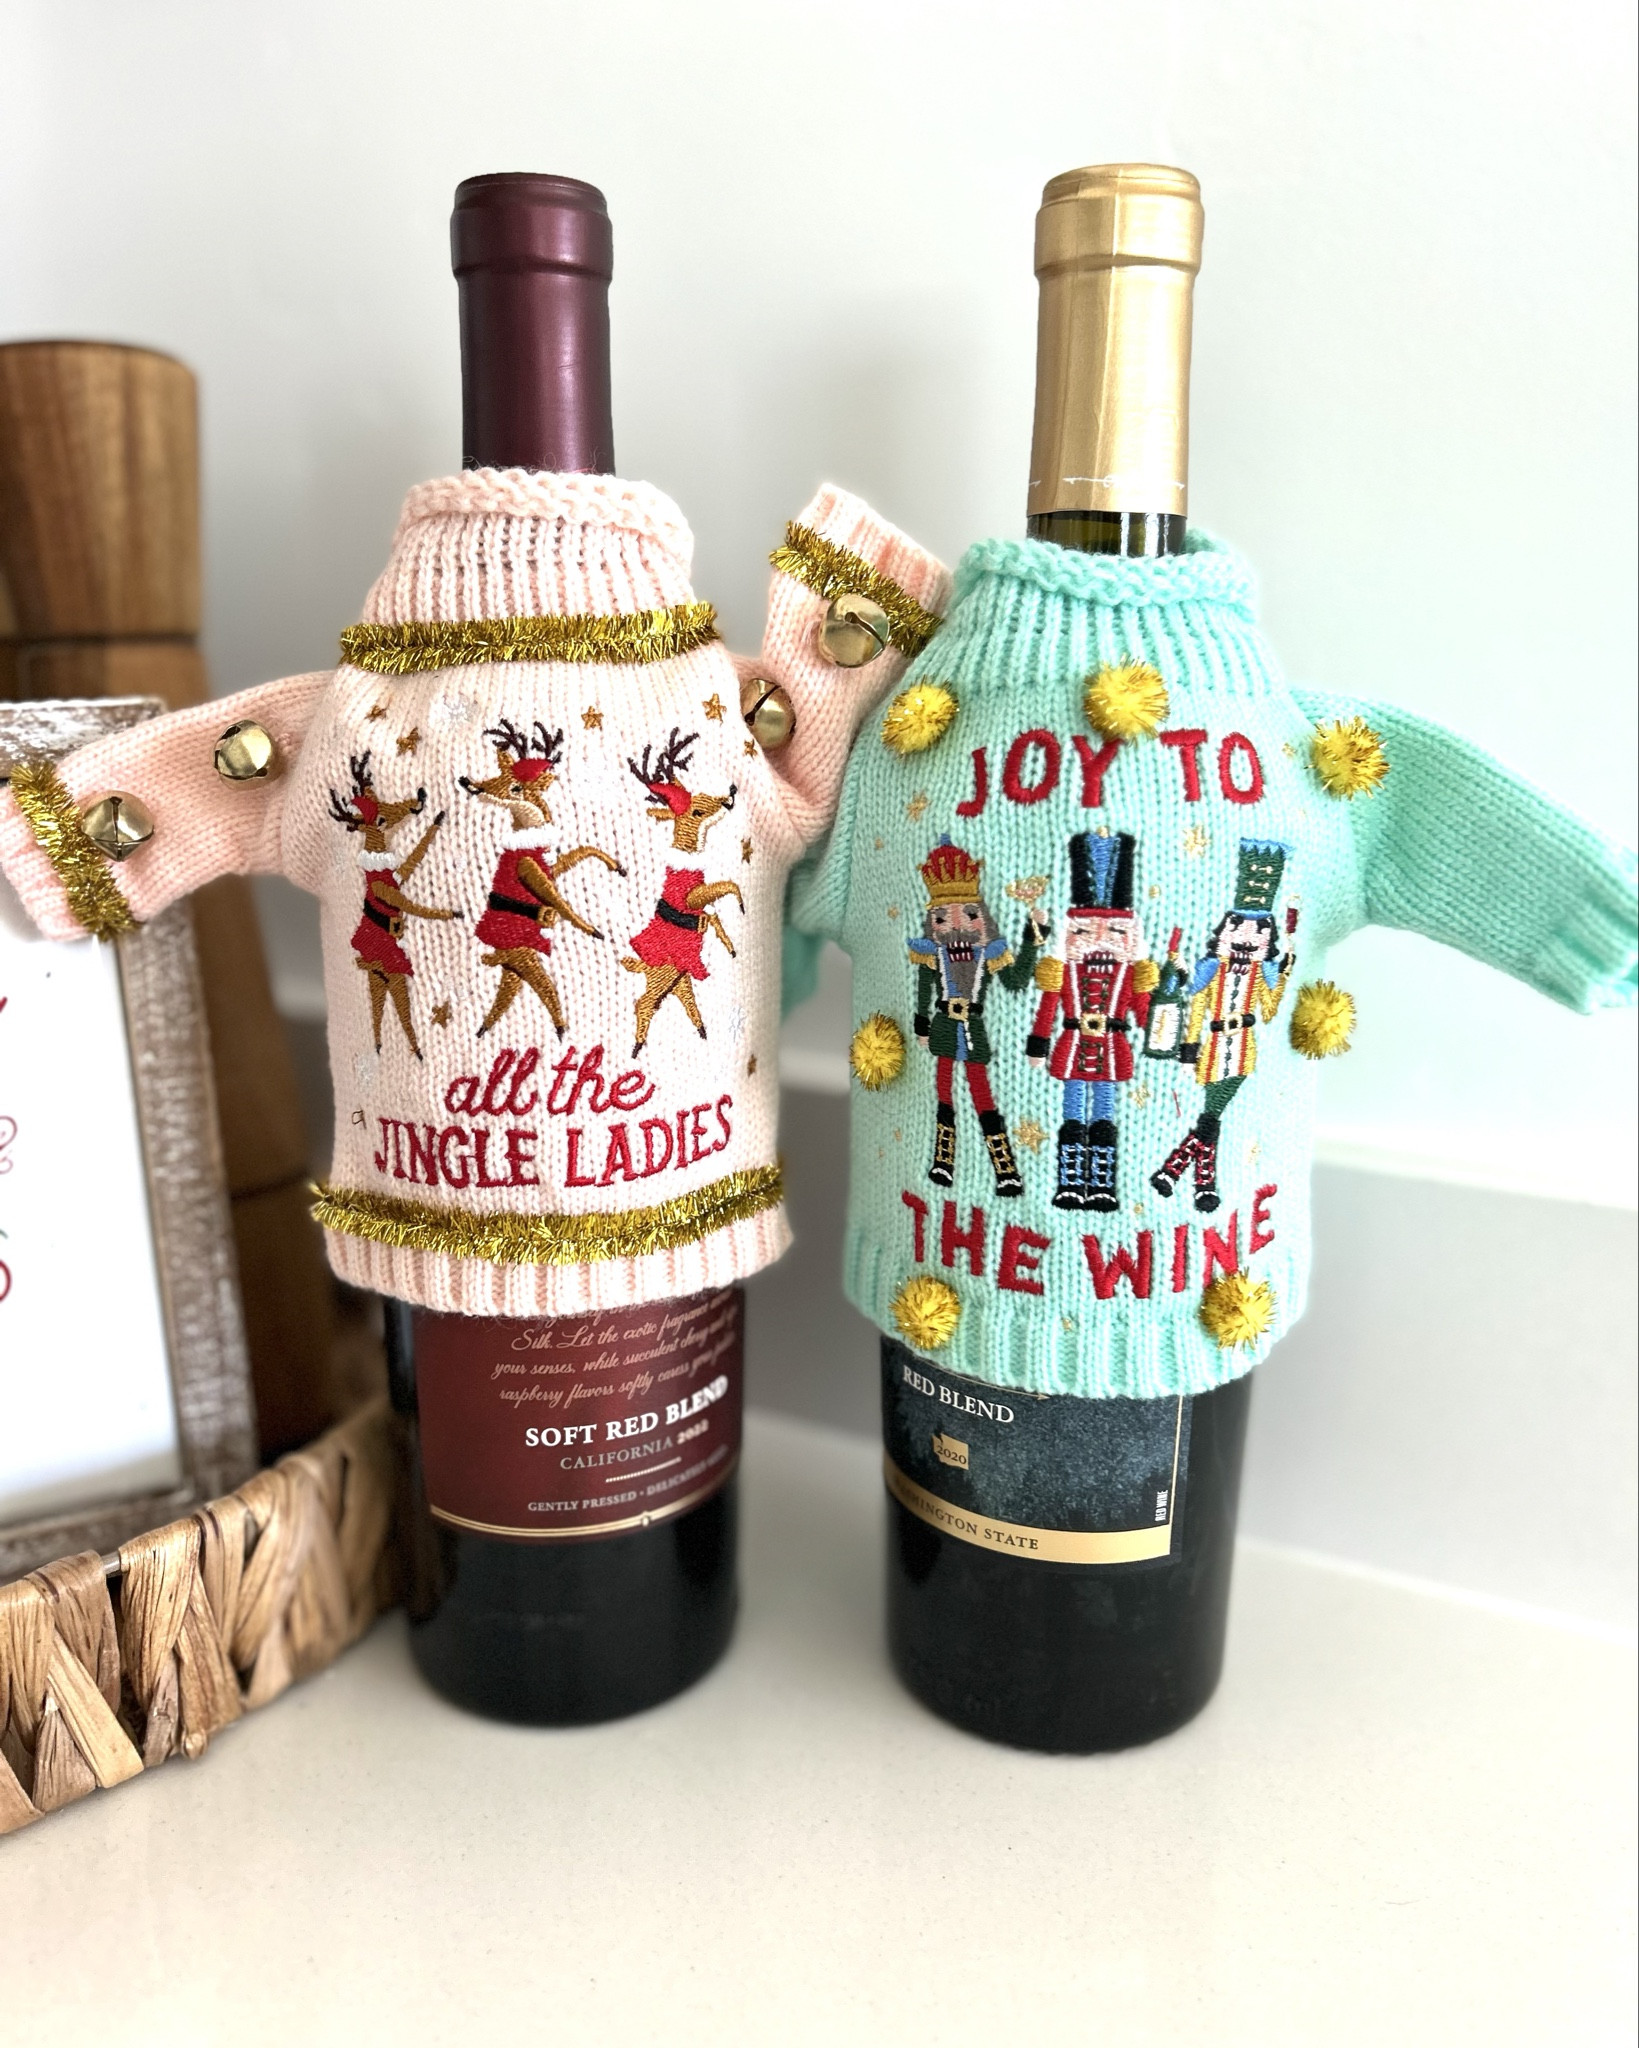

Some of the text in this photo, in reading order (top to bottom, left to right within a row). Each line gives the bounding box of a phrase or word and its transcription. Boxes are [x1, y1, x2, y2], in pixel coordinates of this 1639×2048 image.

[956, 728, 1264, 818] JOY TO
[444, 1043, 656, 1117] all the
[374, 1094, 733, 1188] JINGLE LADIES
[901, 1184, 1278, 1299] THE WINE
[511, 1329, 553, 1351] Silk.
[556, 1325, 594, 1349] Let
[597, 1324, 619, 1345] the
[623, 1321, 658, 1341] exotic
[491, 1362, 527, 1380] your
[530, 1363, 576, 1375] senses,
[583, 1351, 620, 1372] while
[623, 1338, 680, 1366] succulent
[500, 1384, 563, 1409] raspberry
[563, 1383, 615, 1409] flavors
[618, 1371, 654, 1400] softly
[903, 1365, 1015, 1424] RED BLEND
[525, 1375, 728, 1447] SOFT RED BLEND
[560, 1436, 673, 1470] CALIFORNIA
[936, 1445, 968, 1465] 2020
[528, 1500, 579, 1512] GENTLY
[582, 1490, 637, 1509] PRESSED
[1154, 1489, 1168, 1522] RED WINE
[984, 1527, 1039, 1550] STATE
